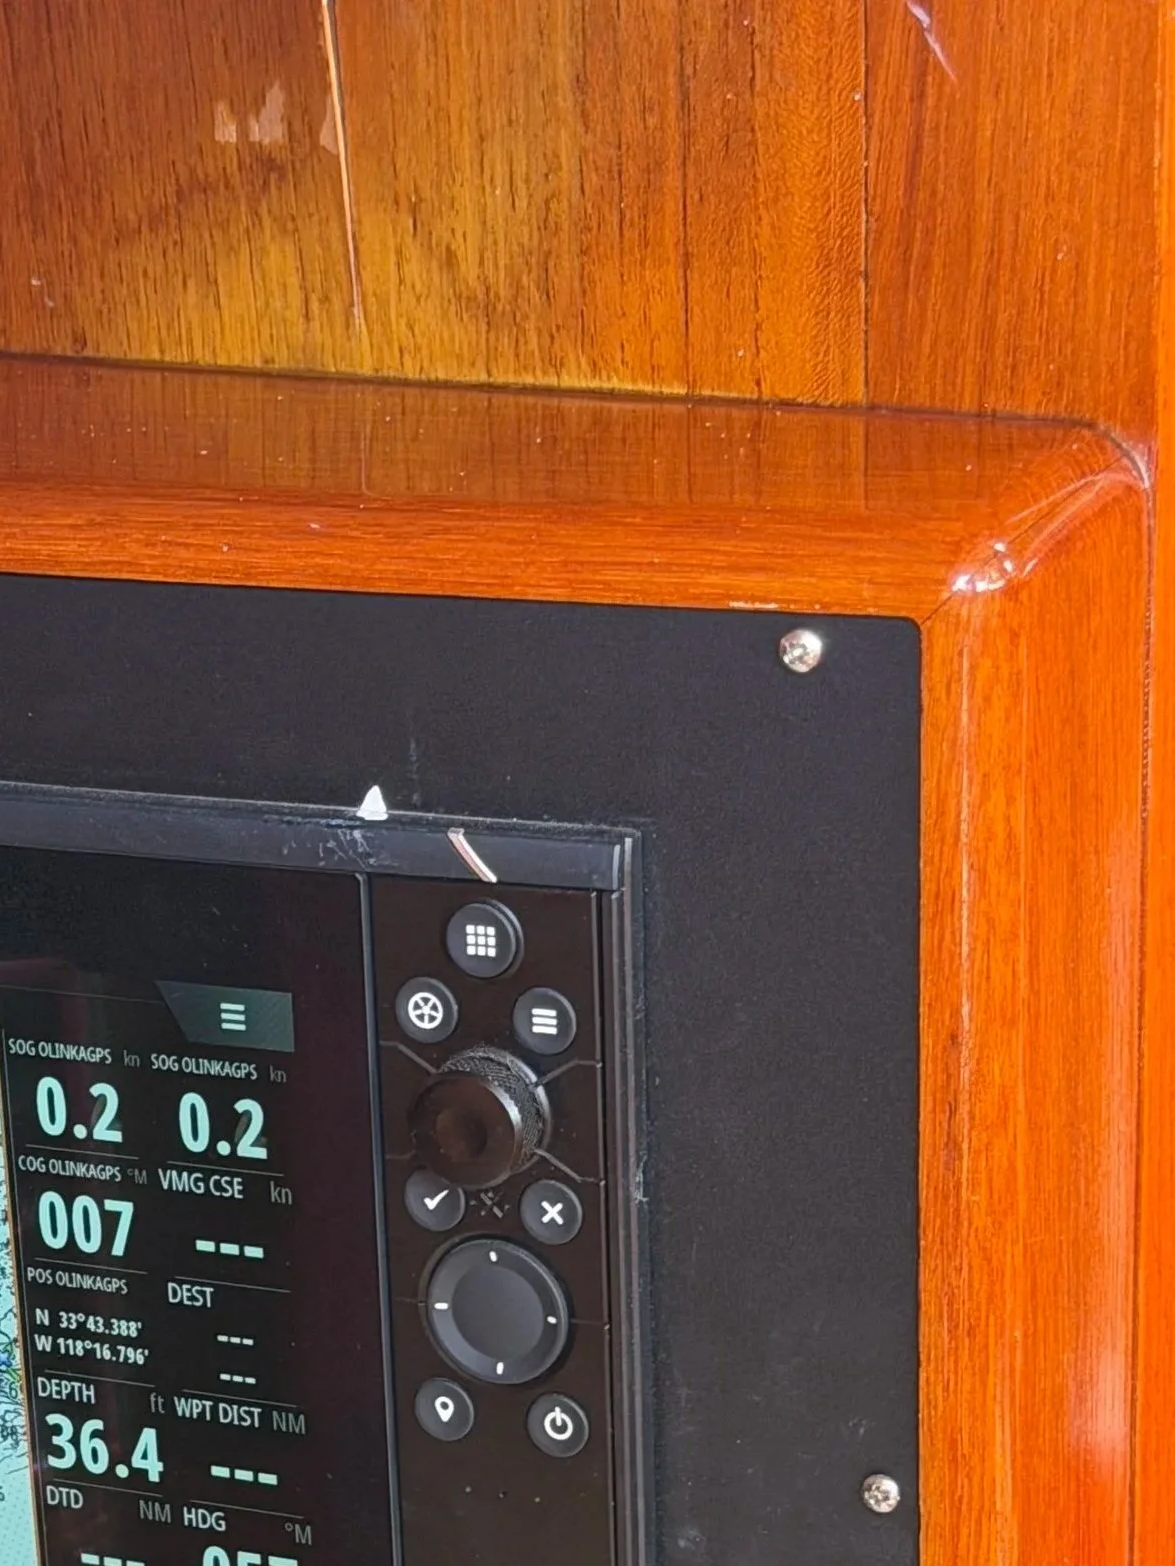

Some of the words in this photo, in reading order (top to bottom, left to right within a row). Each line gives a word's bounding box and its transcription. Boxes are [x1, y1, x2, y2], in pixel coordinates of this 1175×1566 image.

[8, 1038, 36, 1056] SOG
[38, 1043, 112, 1065] OLINKAGPS
[124, 1050, 141, 1069] kn
[150, 1053, 179, 1072] SOG
[182, 1057, 258, 1080] OLINKAGPS
[270, 1065, 287, 1084] kn
[36, 1076, 123, 1143] 0.2
[179, 1092, 268, 1159] 0.2
[18, 1155, 46, 1174] COG
[48, 1159, 122, 1183] OLINKAGPS
[158, 1168, 205, 1195] VMG
[209, 1177, 244, 1200] CSE
[270, 1182, 293, 1206] kn
[38, 1191, 134, 1257] 007
[27, 1266, 53, 1285] POS
[55, 1270, 128, 1296] OLINKAGPS
[167, 1282, 214, 1308] DEST
[36, 1308, 50, 1327] N
[34, 1333, 53, 1353] W
[37, 1376, 95, 1405] DEPTH
[150, 1392, 165, 1415] ft
[174, 1396, 213, 1423] WPT
[218, 1402, 262, 1429] DIST
[272, 1410, 306, 1436] NM
[44, 1412, 164, 1483] 36.4
[46, 1484, 83, 1510] DTD
[139, 1499, 172, 1525] NM
[183, 1506, 226, 1532] HDG
